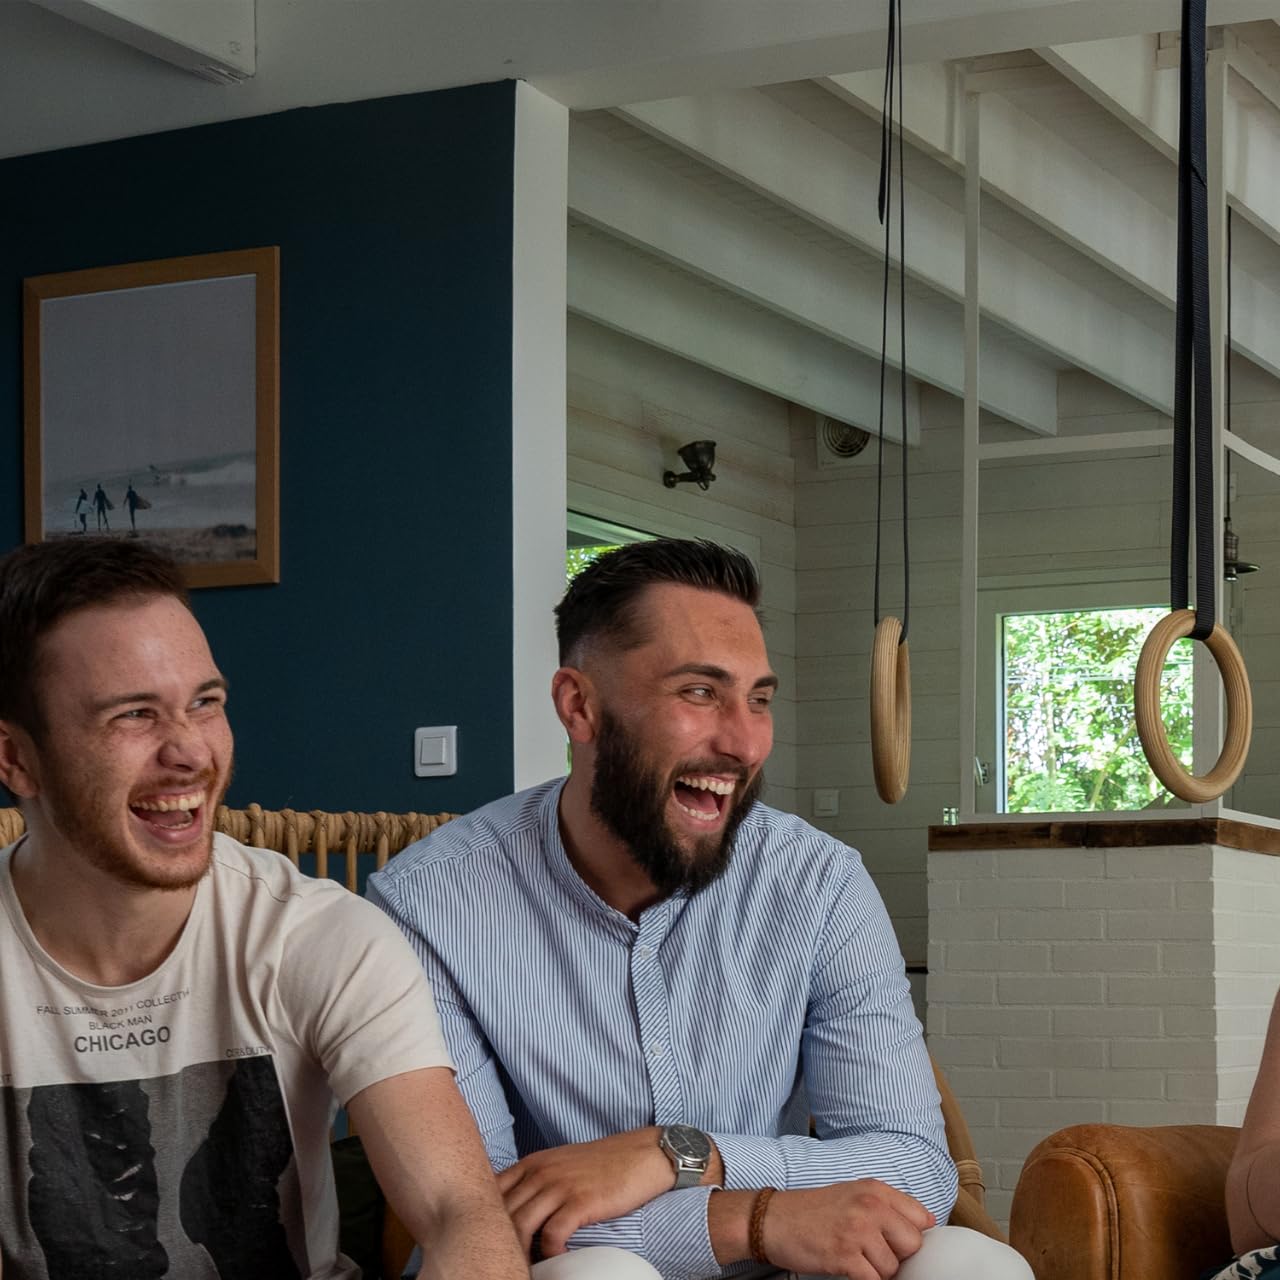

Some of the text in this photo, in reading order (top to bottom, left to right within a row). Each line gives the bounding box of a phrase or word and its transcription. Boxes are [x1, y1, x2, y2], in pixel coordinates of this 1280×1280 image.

[88, 1014, 153, 1031] BLACK MAN
[74, 1026, 171, 1053] CHICAGO
